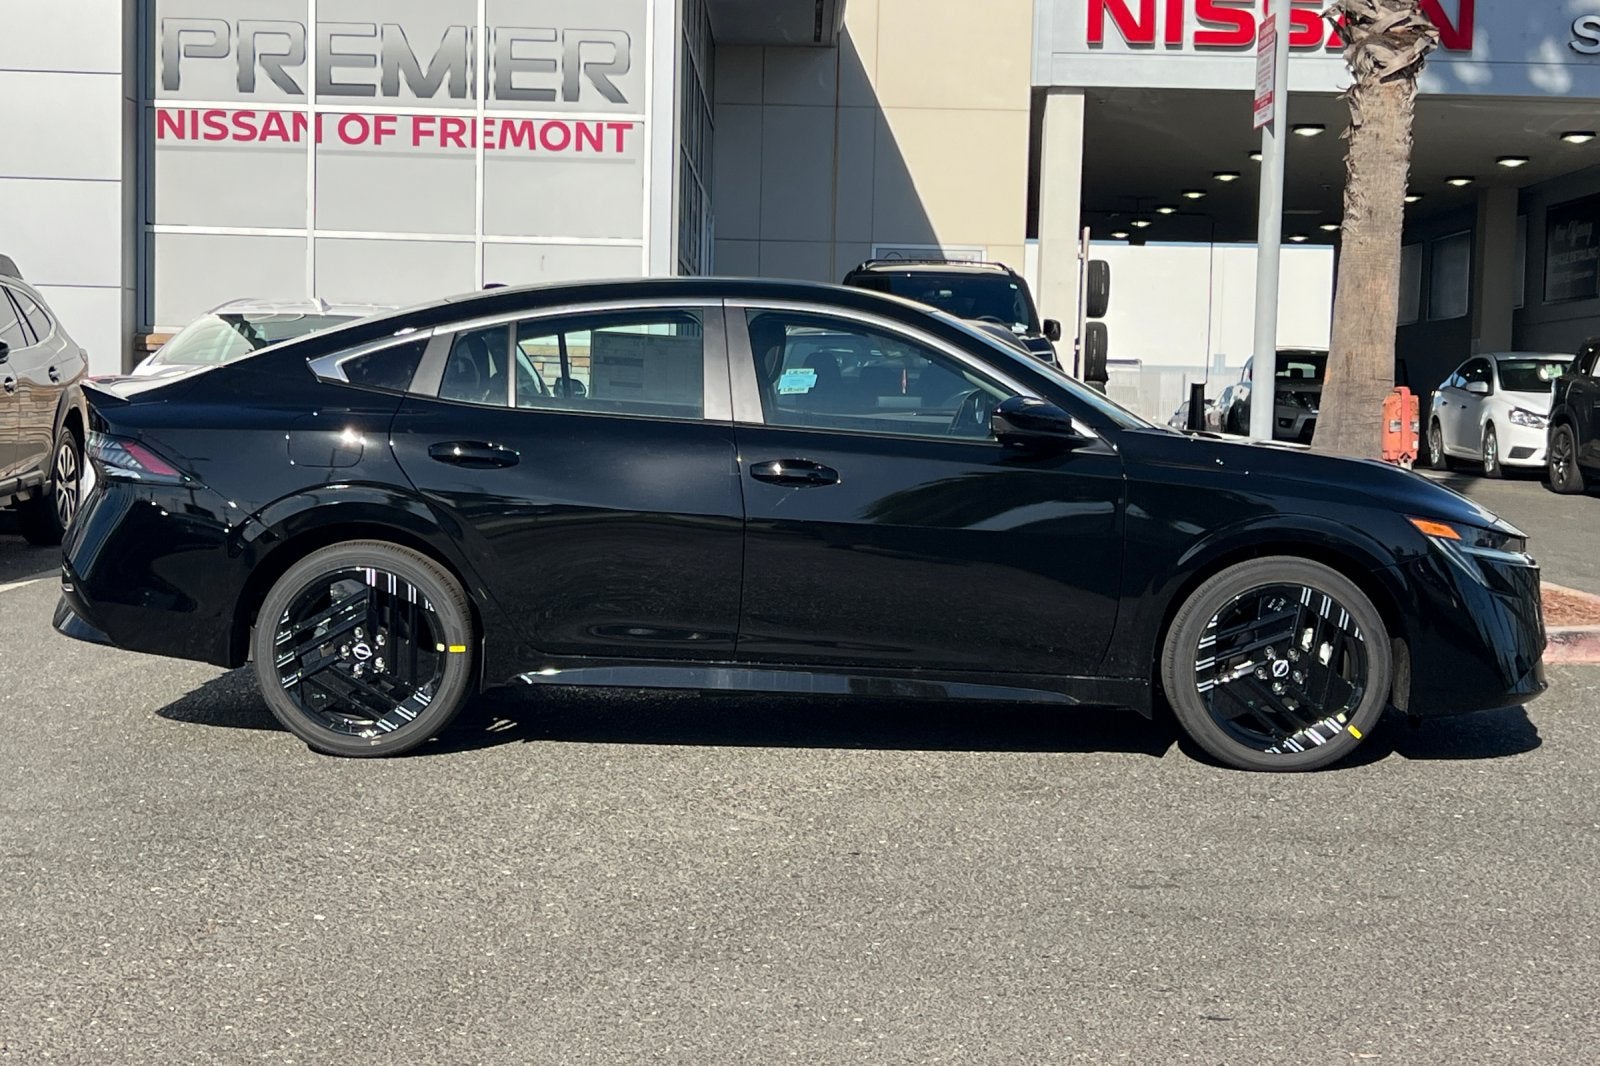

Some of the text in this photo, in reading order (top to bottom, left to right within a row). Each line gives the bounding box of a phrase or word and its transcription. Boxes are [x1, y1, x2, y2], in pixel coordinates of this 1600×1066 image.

[1086, 0, 1474, 50] NISSN
[161, 17, 631, 104] PREMIER
[157, 109, 633, 152] NISSAN OF FREMONT
